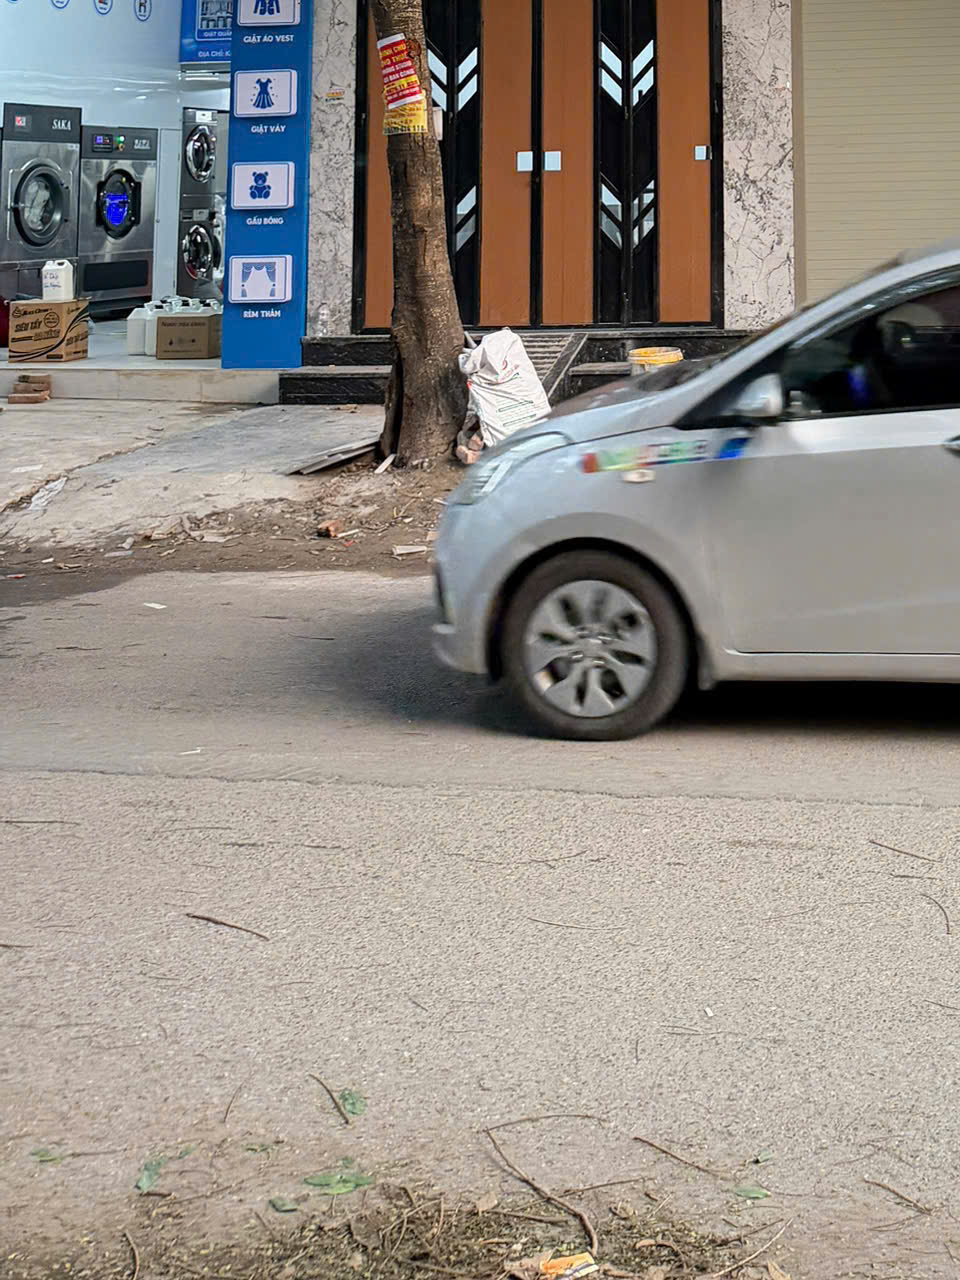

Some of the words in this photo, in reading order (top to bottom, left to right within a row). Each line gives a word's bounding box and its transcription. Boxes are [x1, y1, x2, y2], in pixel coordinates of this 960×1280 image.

[243, 34, 262, 46] GIẶT
[275, 33, 295, 43] VEST
[251, 124, 267, 135] GIẶT
